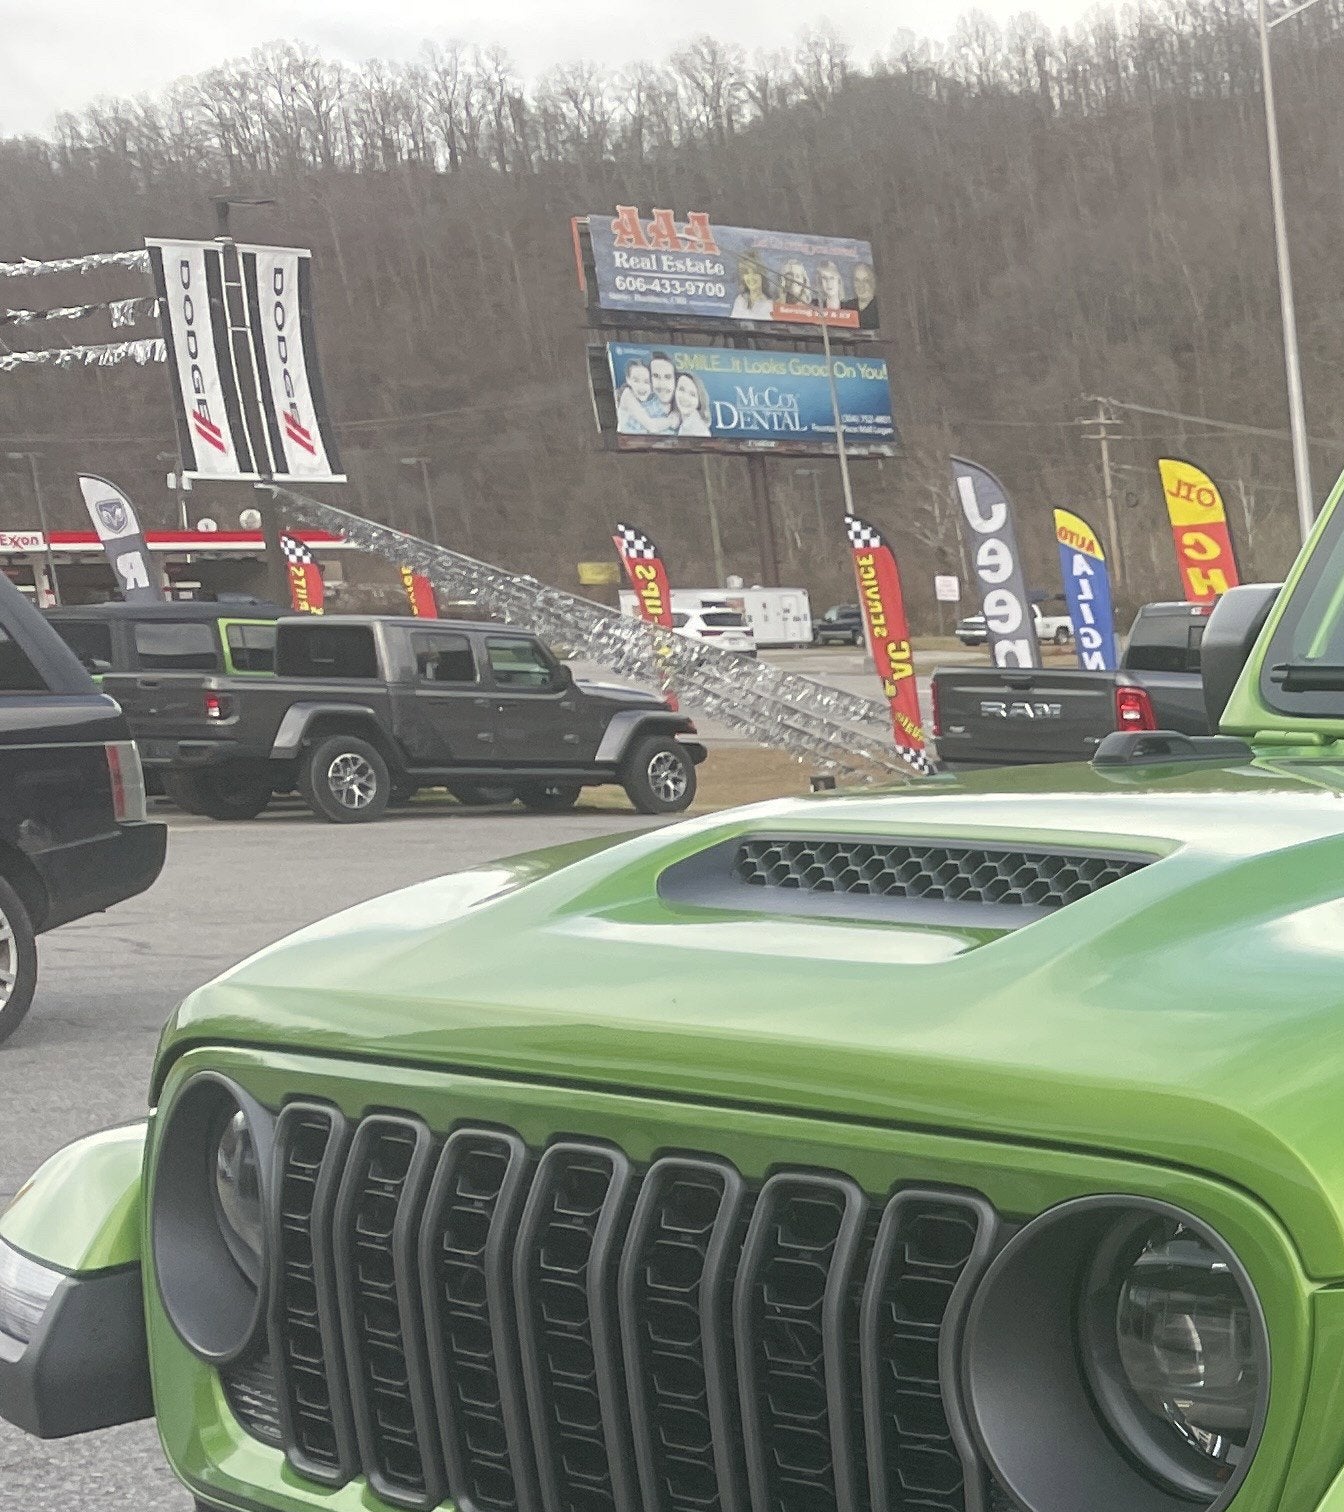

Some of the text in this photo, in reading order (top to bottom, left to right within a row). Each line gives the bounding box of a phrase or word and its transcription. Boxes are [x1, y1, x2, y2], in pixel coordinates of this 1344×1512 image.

[611, 205, 720, 255] AAA
[613, 252, 726, 276] Real Estate
[614, 276, 726, 299] 606-433-9700
[180, 260, 212, 427] DODGE
[273, 267, 302, 428] DODGE
[742, 357, 787, 375] Looks
[790, 358, 831, 378] Good
[833, 361, 856, 379] On
[858, 363, 888, 381] You!
[713, 401, 808, 432] DENTAL
[0, 534, 39, 549] Exxon
[980, 701, 1062, 719] RAM
